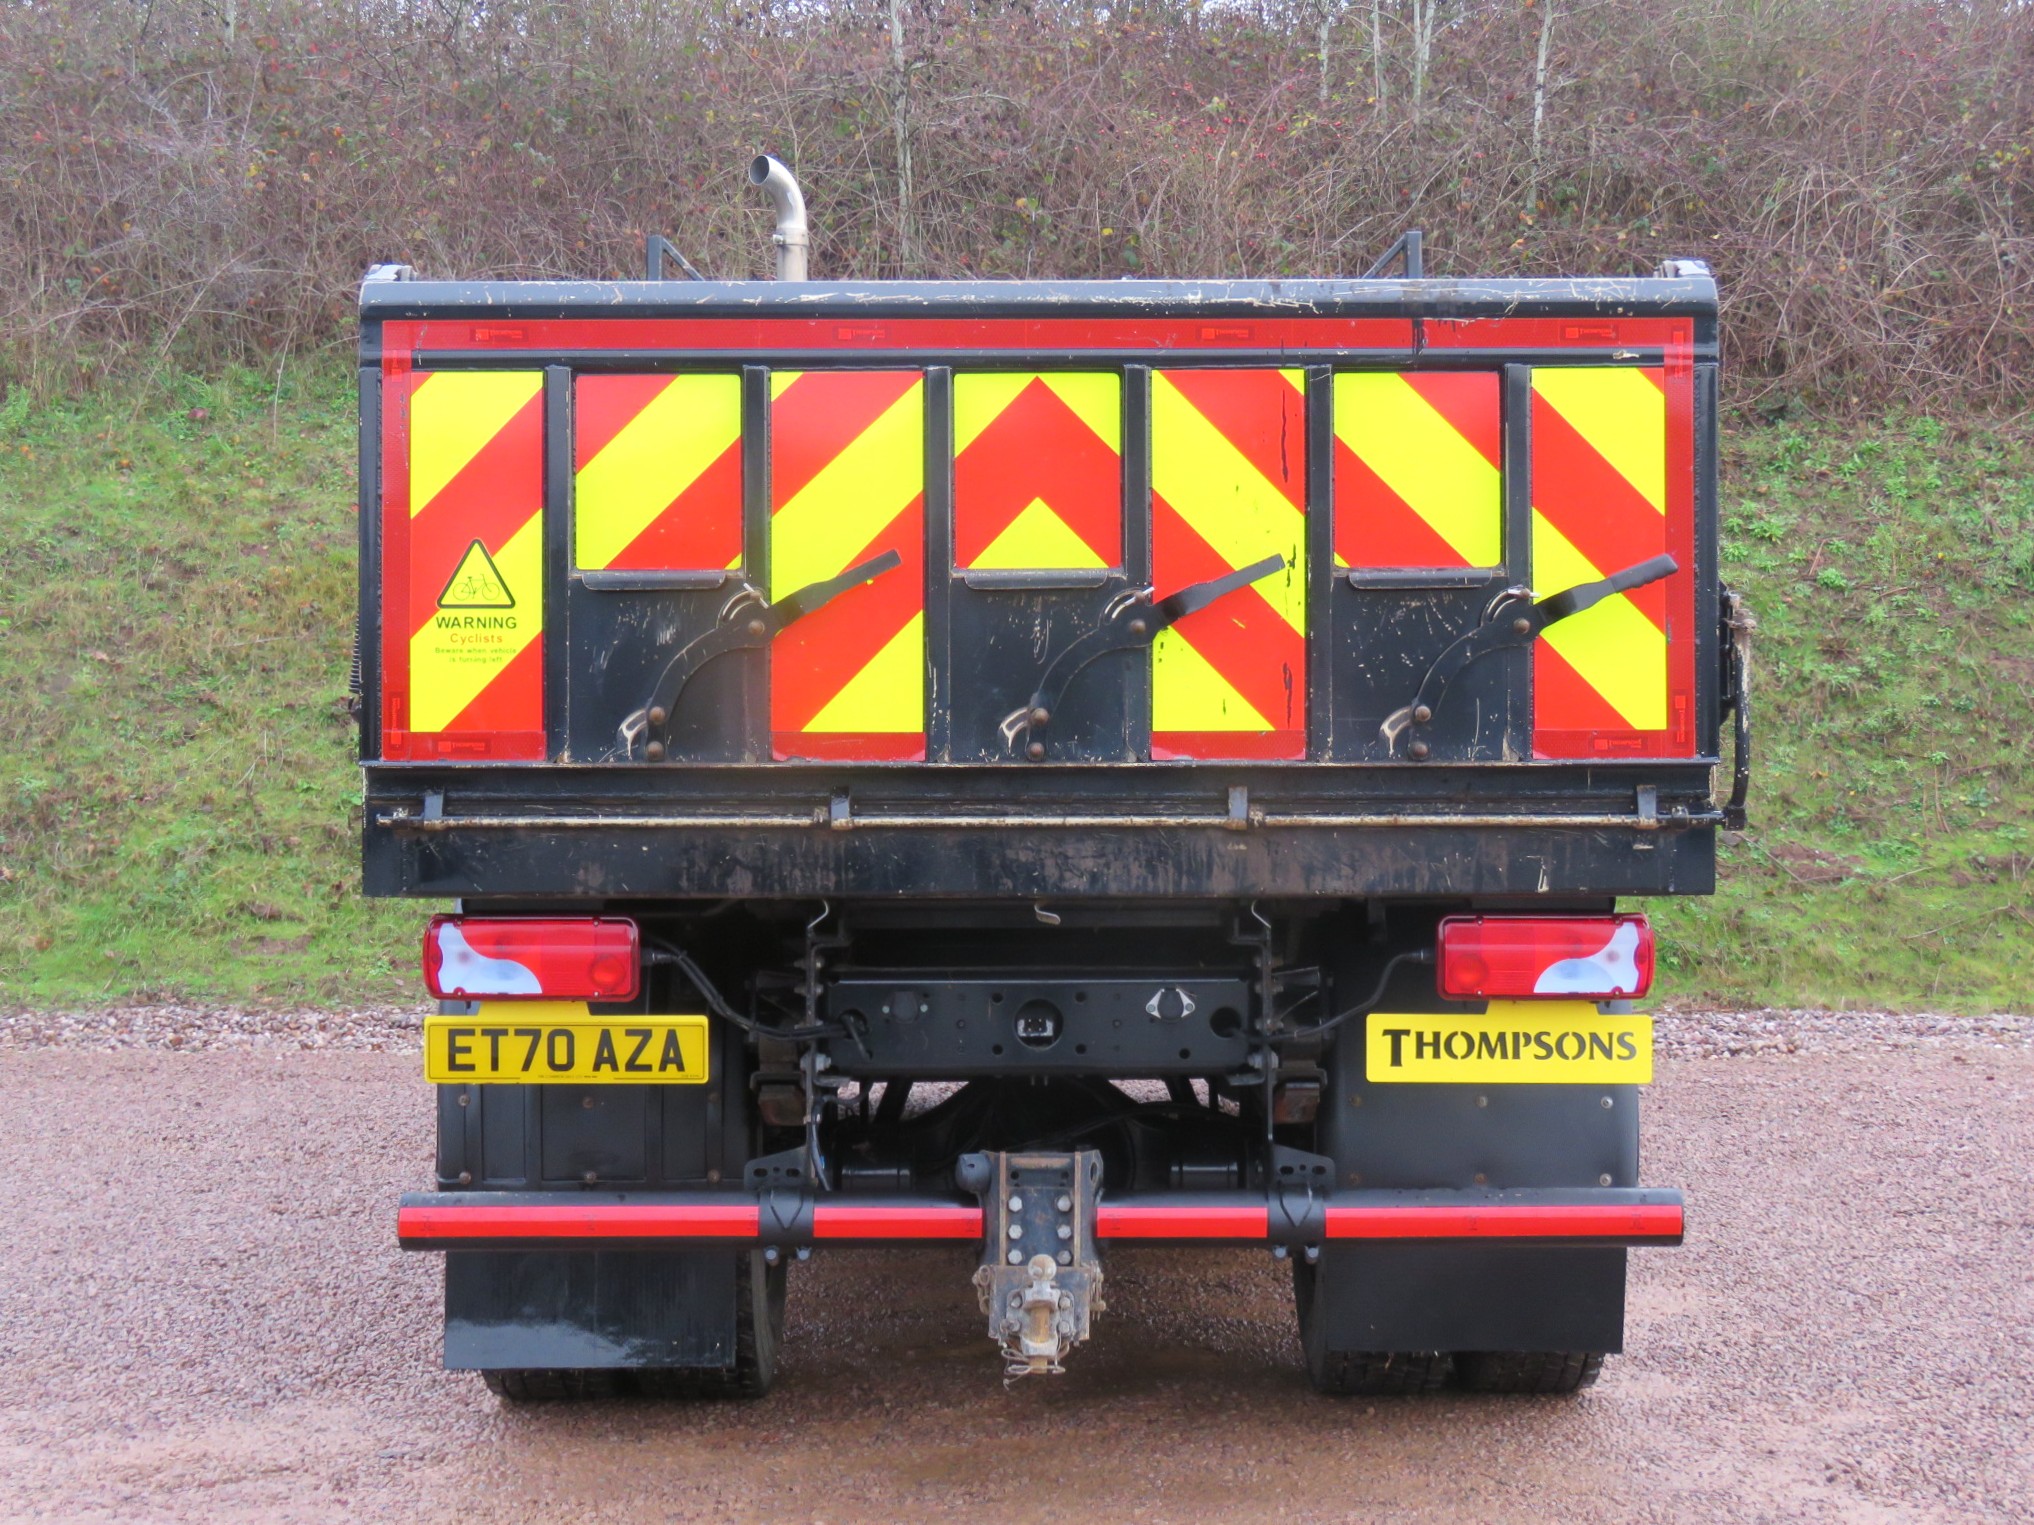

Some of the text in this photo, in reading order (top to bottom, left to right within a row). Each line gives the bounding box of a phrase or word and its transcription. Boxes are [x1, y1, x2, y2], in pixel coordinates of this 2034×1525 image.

[436, 616, 517, 629] WARNING
[450, 633, 503, 645] Cyclists
[459, 656, 487, 664] turning
[447, 1028, 686, 1072] ET70 AZA
[1382, 1028, 1637, 1067] THOMPSONS
